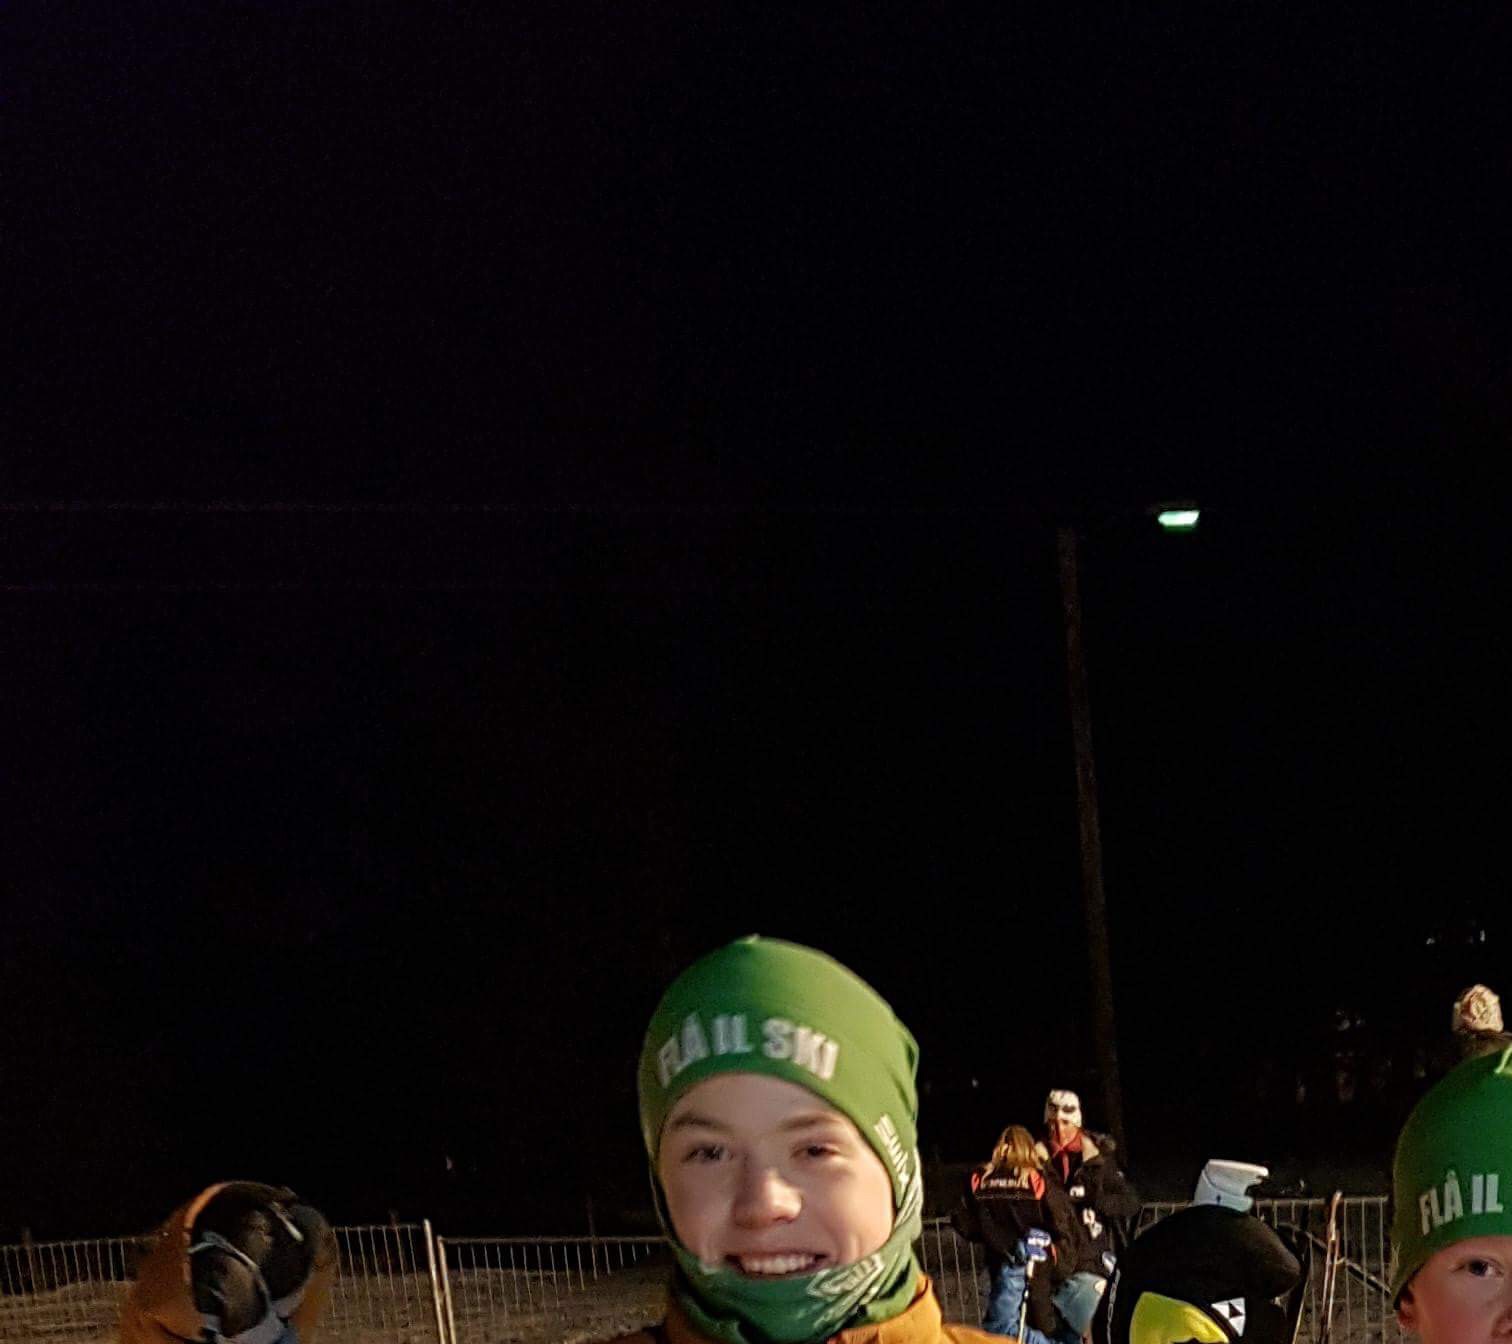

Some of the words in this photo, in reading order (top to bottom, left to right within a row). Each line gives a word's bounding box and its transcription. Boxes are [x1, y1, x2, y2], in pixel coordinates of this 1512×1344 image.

[711, 1014, 755, 1055] IL
[763, 1017, 840, 1080] SKI
[1419, 1168, 1464, 1236] FLÅ
[1471, 1173, 1504, 1215] IL
